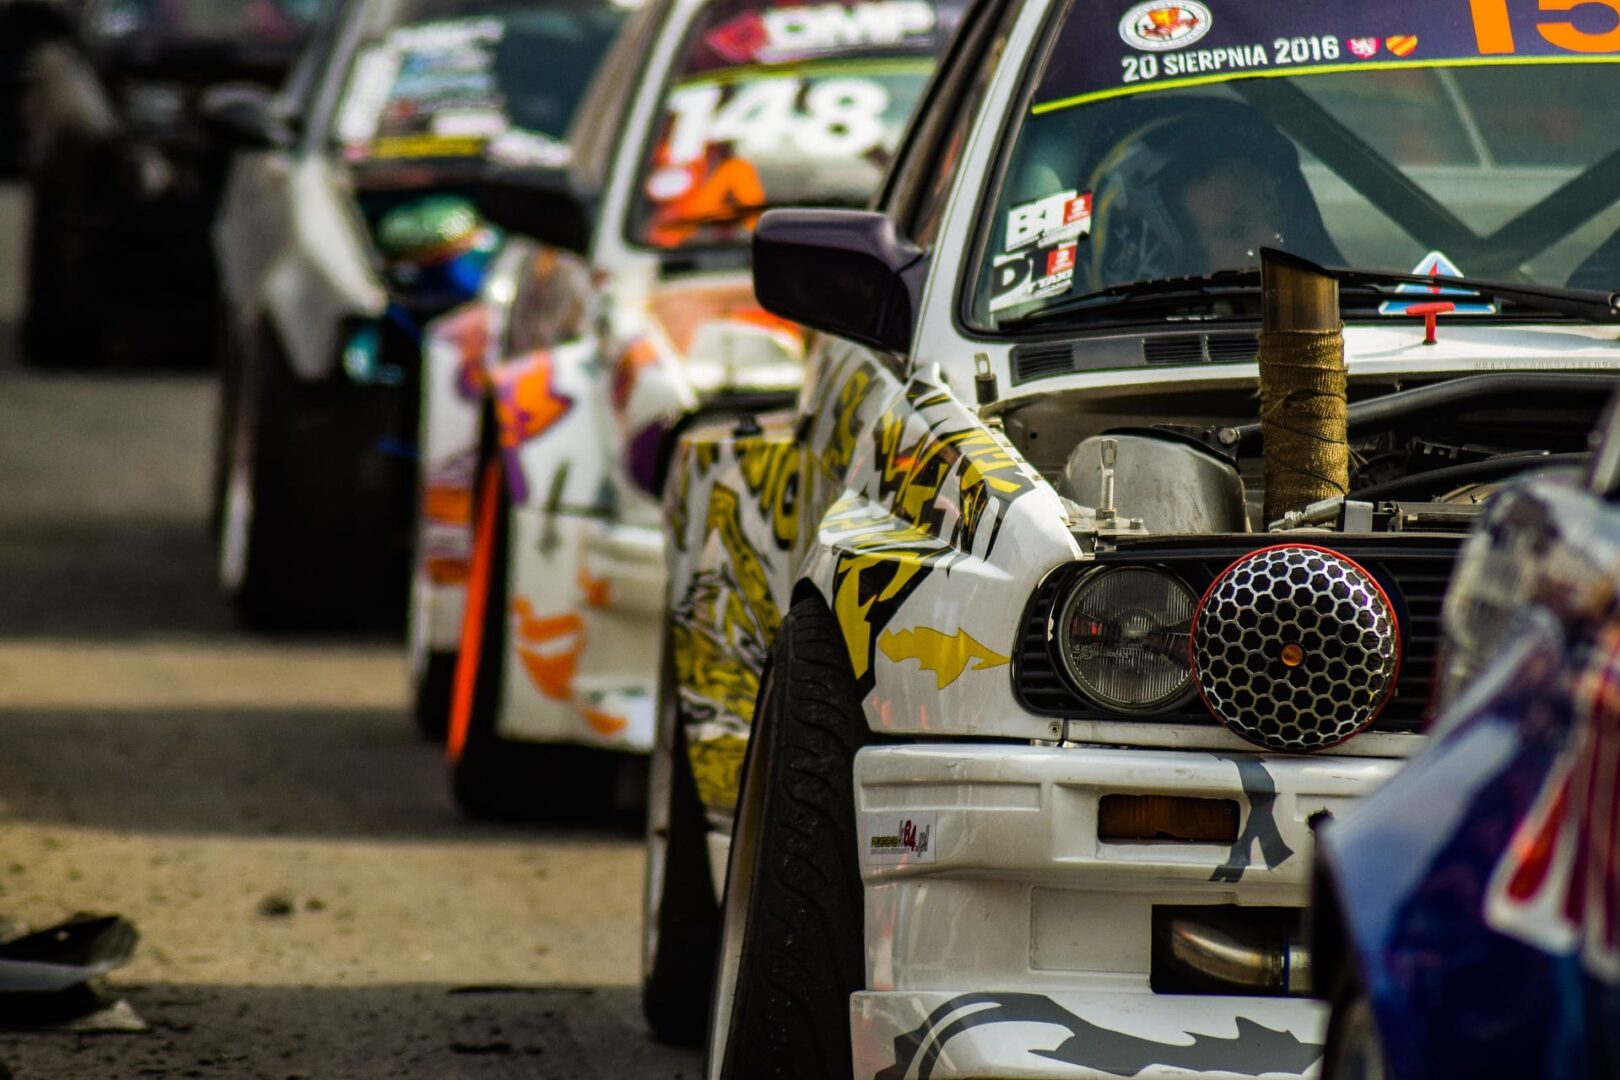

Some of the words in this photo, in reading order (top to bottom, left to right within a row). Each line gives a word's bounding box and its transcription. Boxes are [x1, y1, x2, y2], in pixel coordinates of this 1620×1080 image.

[1121, 53, 1158, 83] 20
[1162, 44, 1268, 76] SIERPNIA
[1273, 35, 1340, 64] 2016
[669, 77, 888, 165] 148
